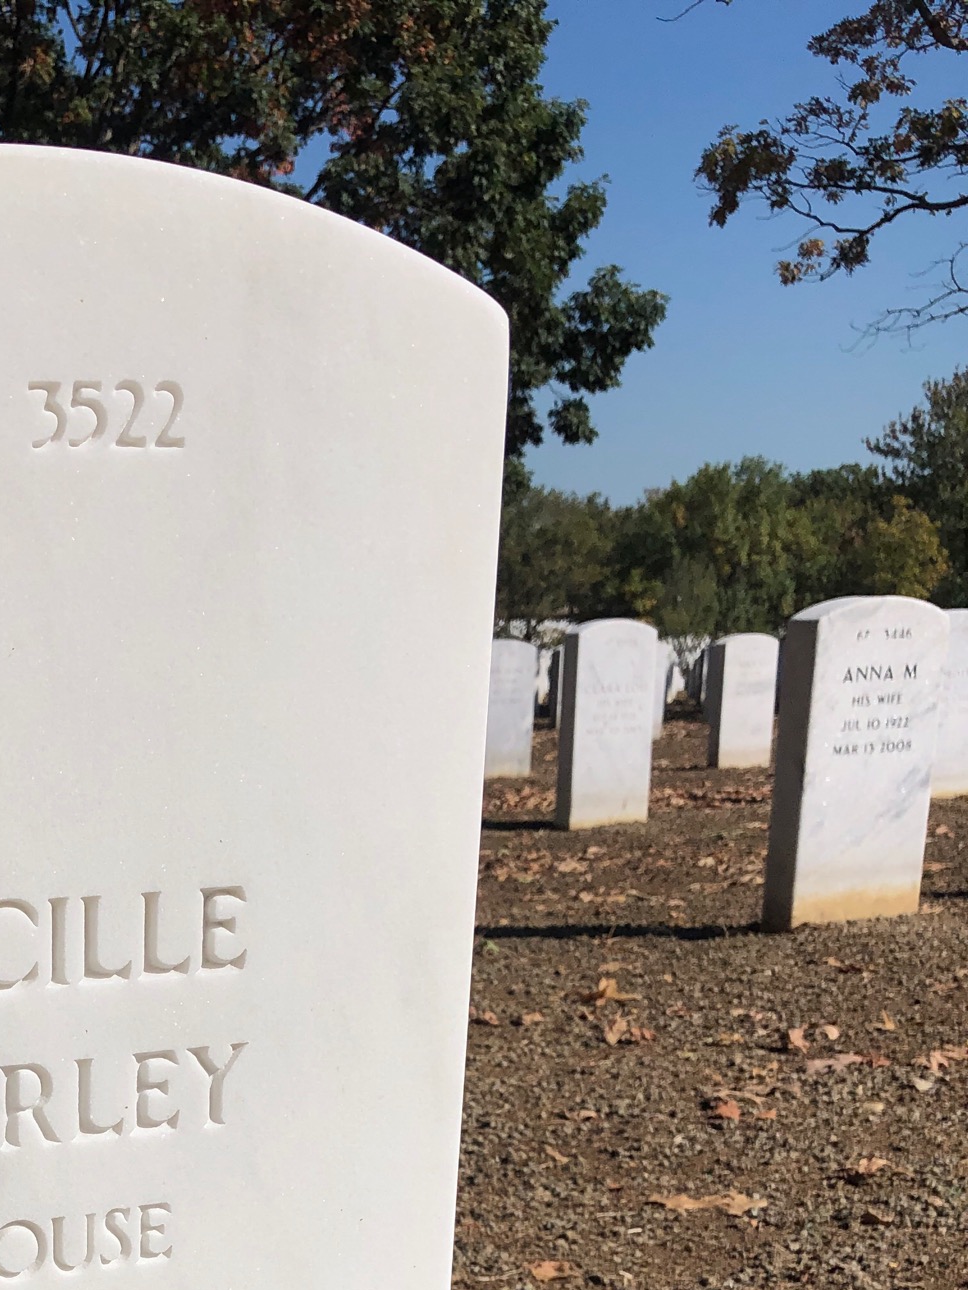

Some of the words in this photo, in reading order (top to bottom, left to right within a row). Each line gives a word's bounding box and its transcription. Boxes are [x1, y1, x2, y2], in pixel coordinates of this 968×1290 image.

[28, 379, 186, 449] 3522
[842, 664, 894, 684] ANNA
[903, 663, 918, 680] M
[851, 694, 871, 707] HIS
[877, 692, 903, 705] WIFE
[840, 719, 861, 732] JUL
[867, 716, 881, 730] 10
[833, 743, 858, 755] MAR
